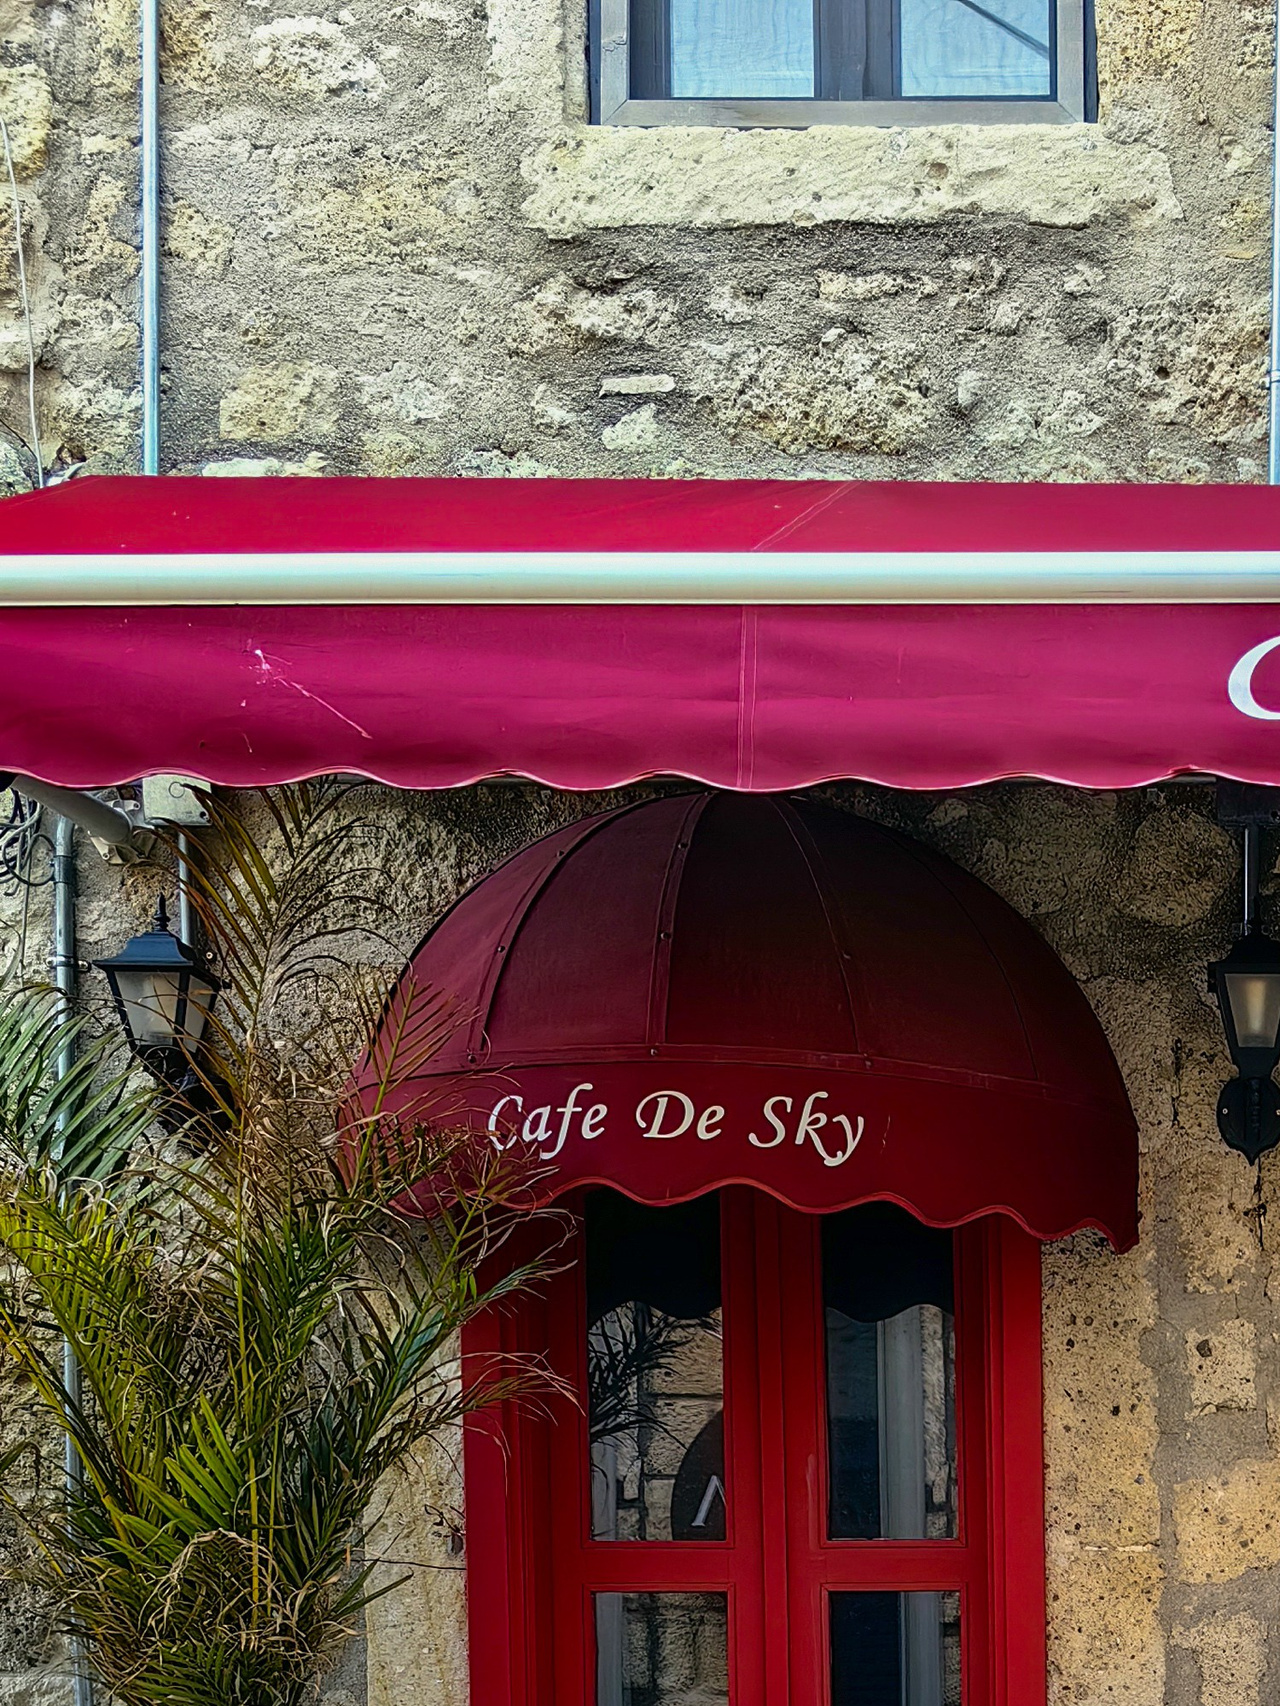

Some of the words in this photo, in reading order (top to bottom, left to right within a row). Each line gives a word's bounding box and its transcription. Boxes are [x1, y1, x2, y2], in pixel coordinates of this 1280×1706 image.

[488, 1082, 609, 1160] Cafe
[635, 1090, 726, 1140] De
[748, 1091, 865, 1167] Sky
